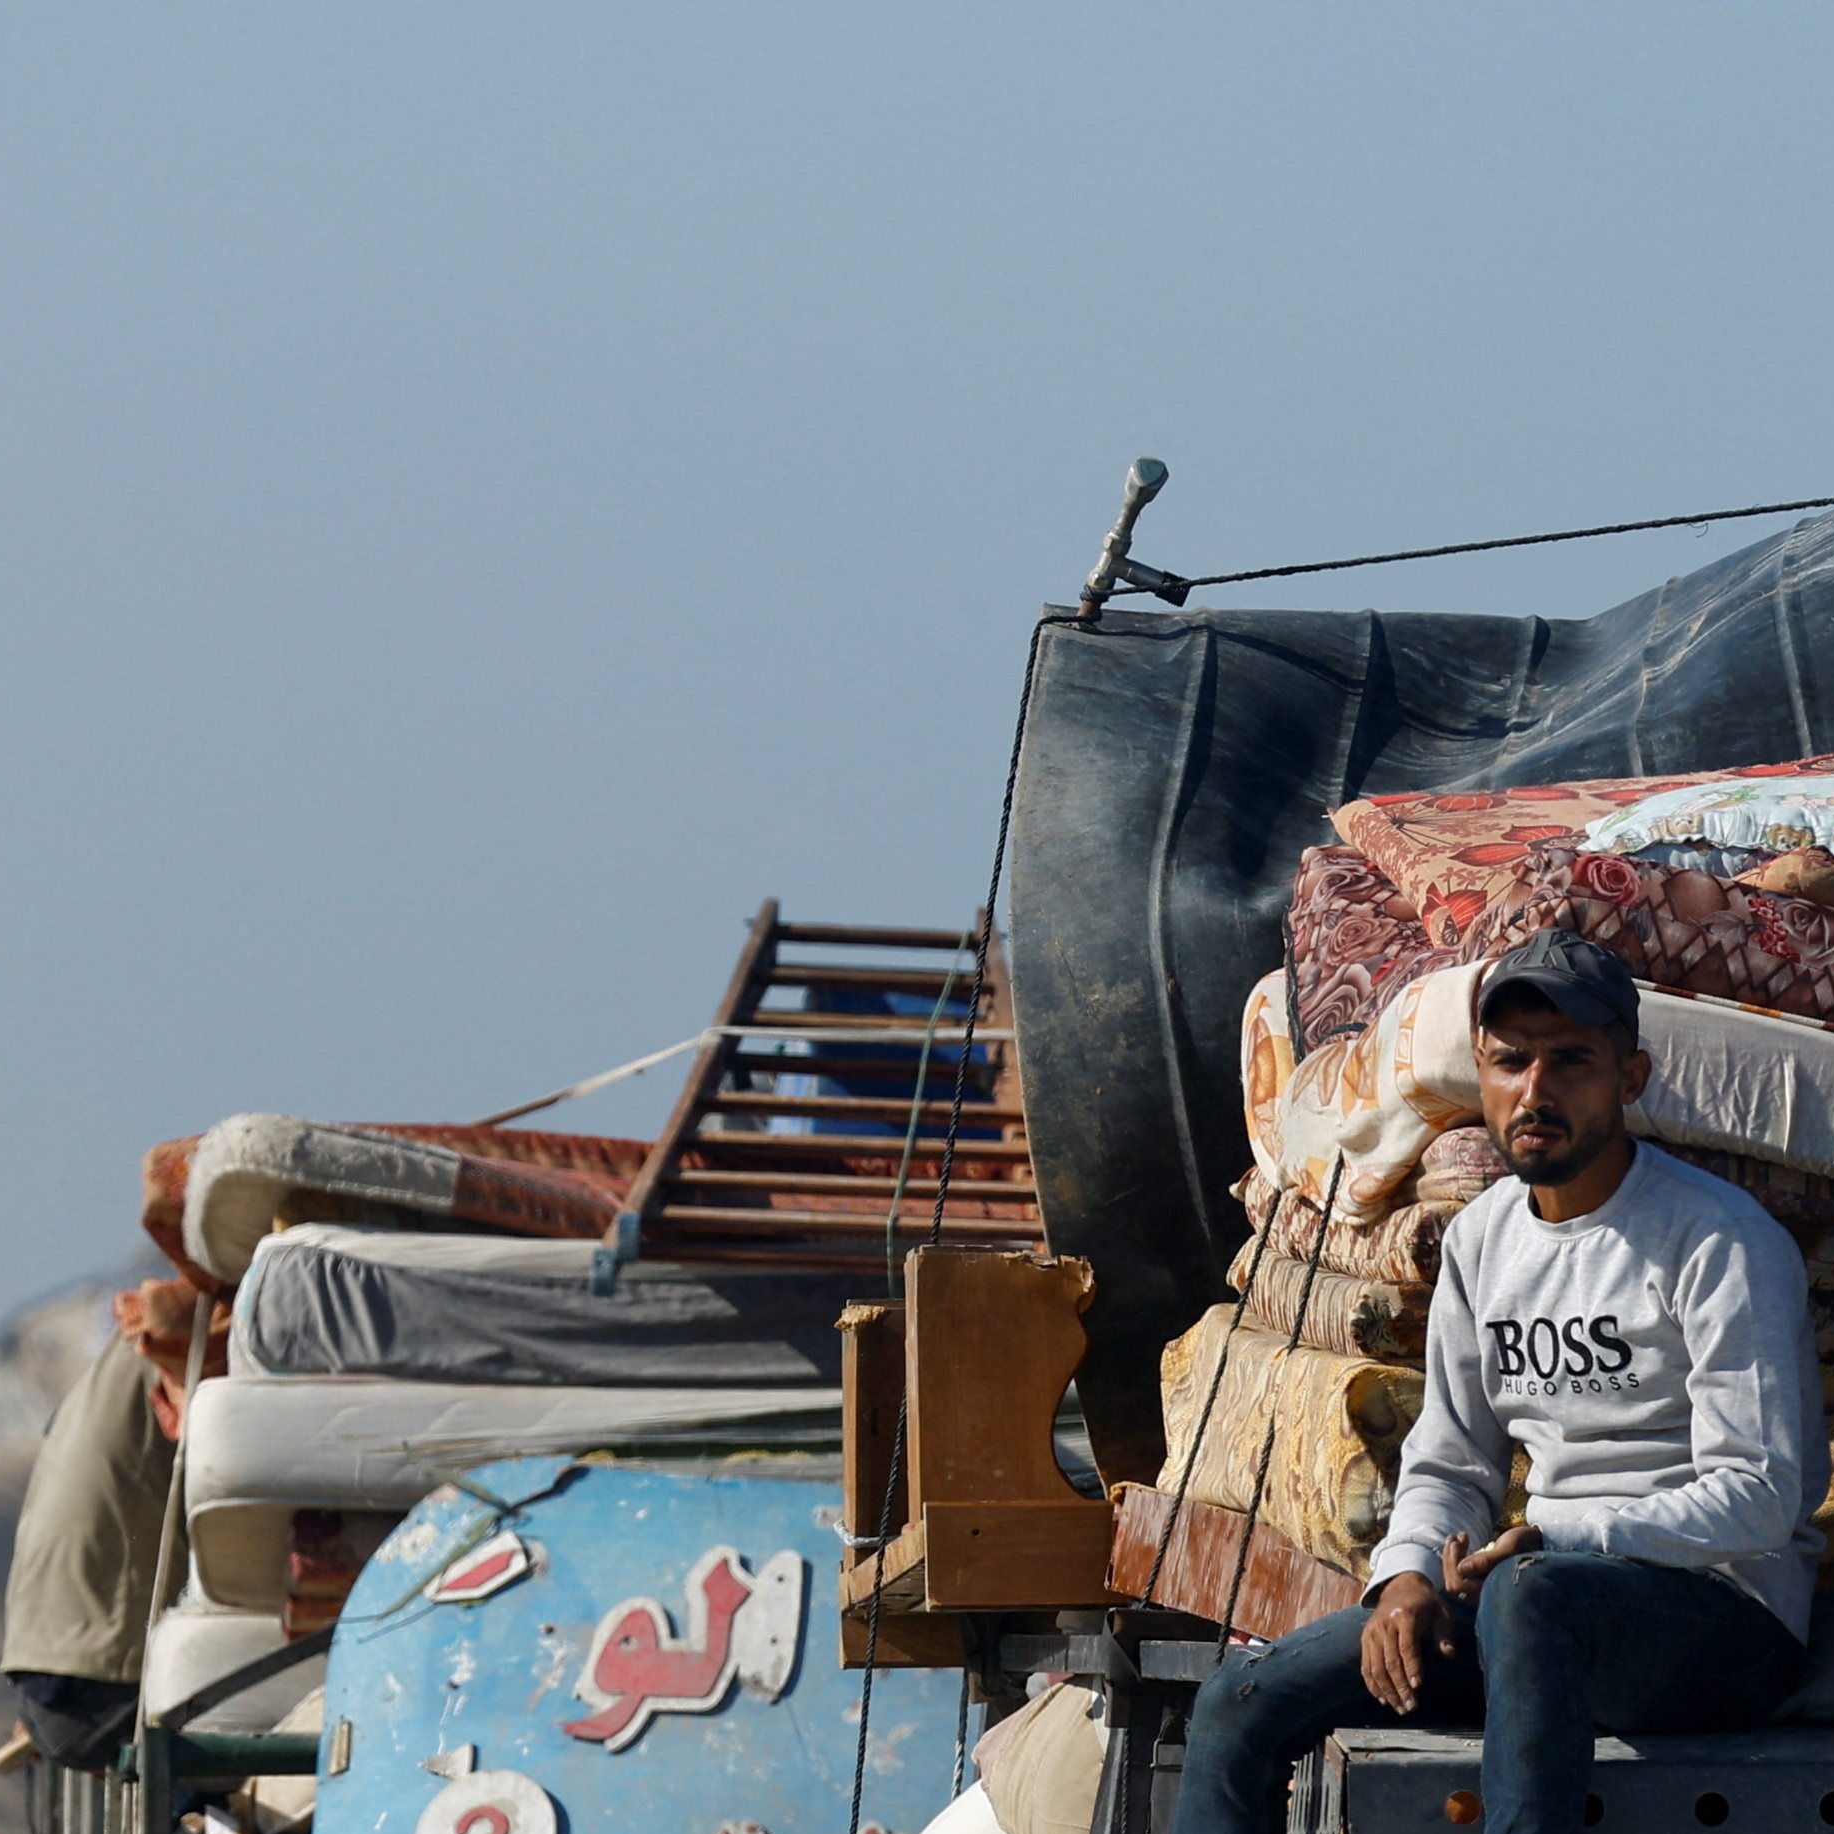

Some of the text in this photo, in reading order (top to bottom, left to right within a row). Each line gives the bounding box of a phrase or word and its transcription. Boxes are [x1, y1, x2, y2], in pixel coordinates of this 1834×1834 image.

[1486, 1314, 1634, 1378] BOSS
[1504, 1372, 1640, 1396] HUGO BOSS
